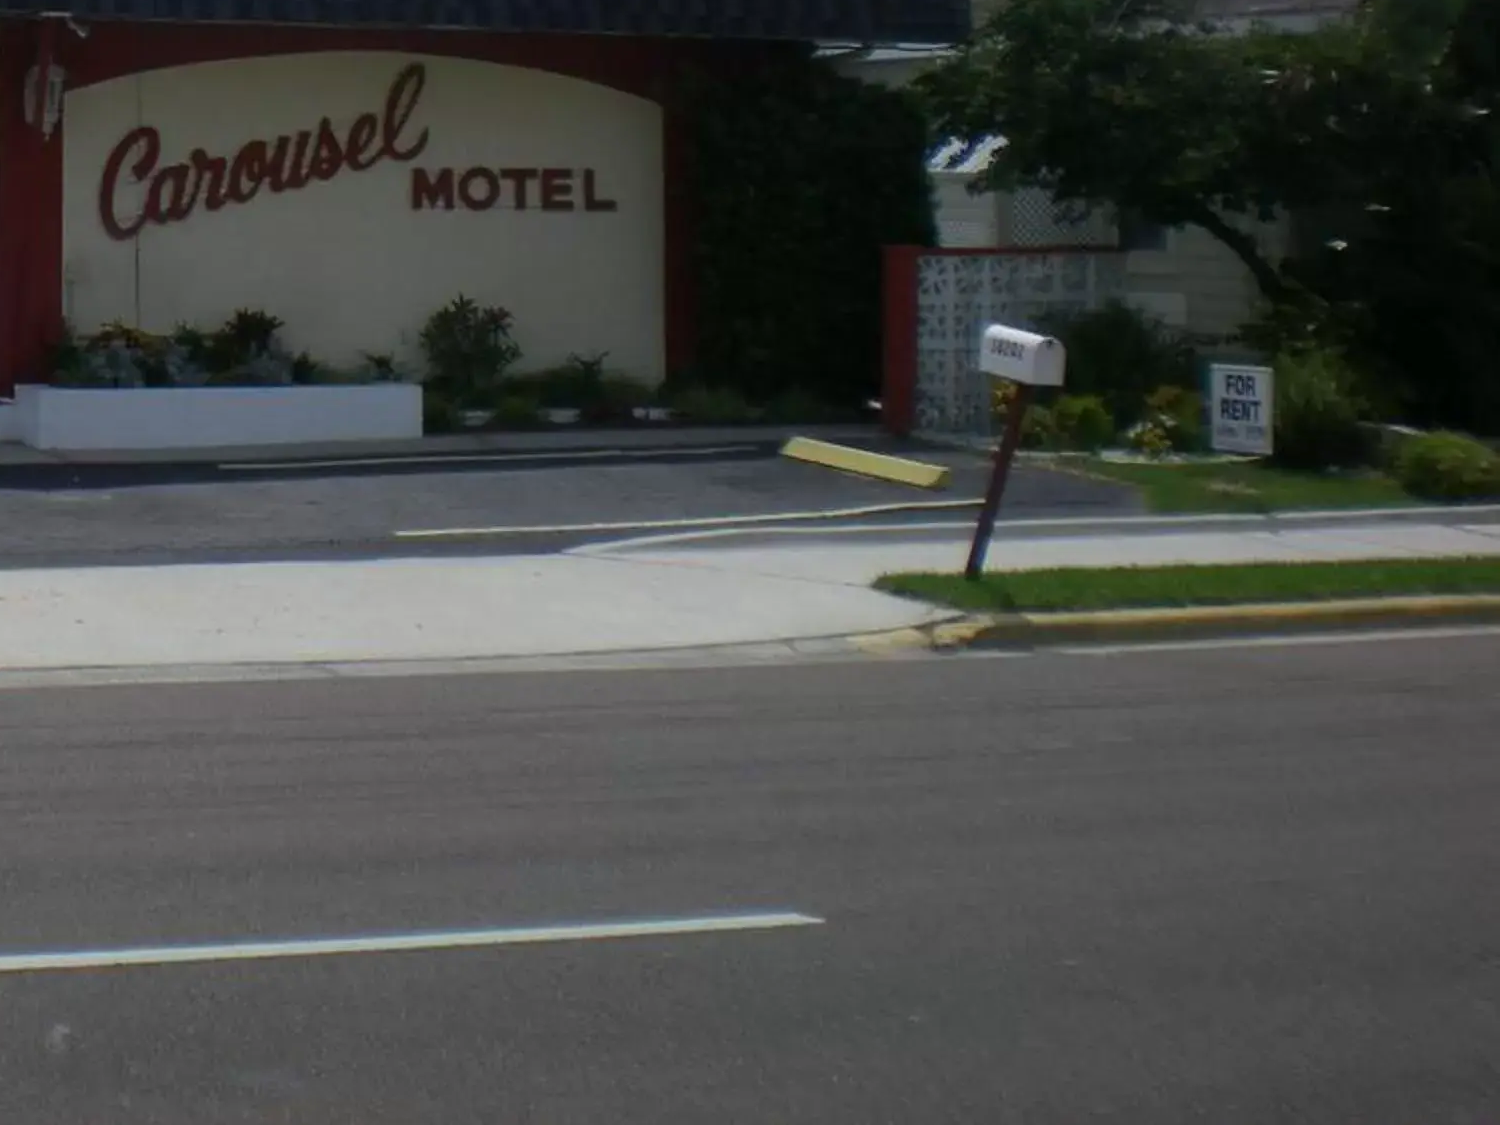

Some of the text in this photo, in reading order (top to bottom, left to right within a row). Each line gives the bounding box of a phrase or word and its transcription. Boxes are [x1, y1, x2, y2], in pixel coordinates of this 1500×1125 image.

[98, 62, 430, 241] Carousel
[411, 166, 618, 212] MOTEL
[1226, 374, 1256, 397] FOR
[1221, 397, 1262, 422] RENT
